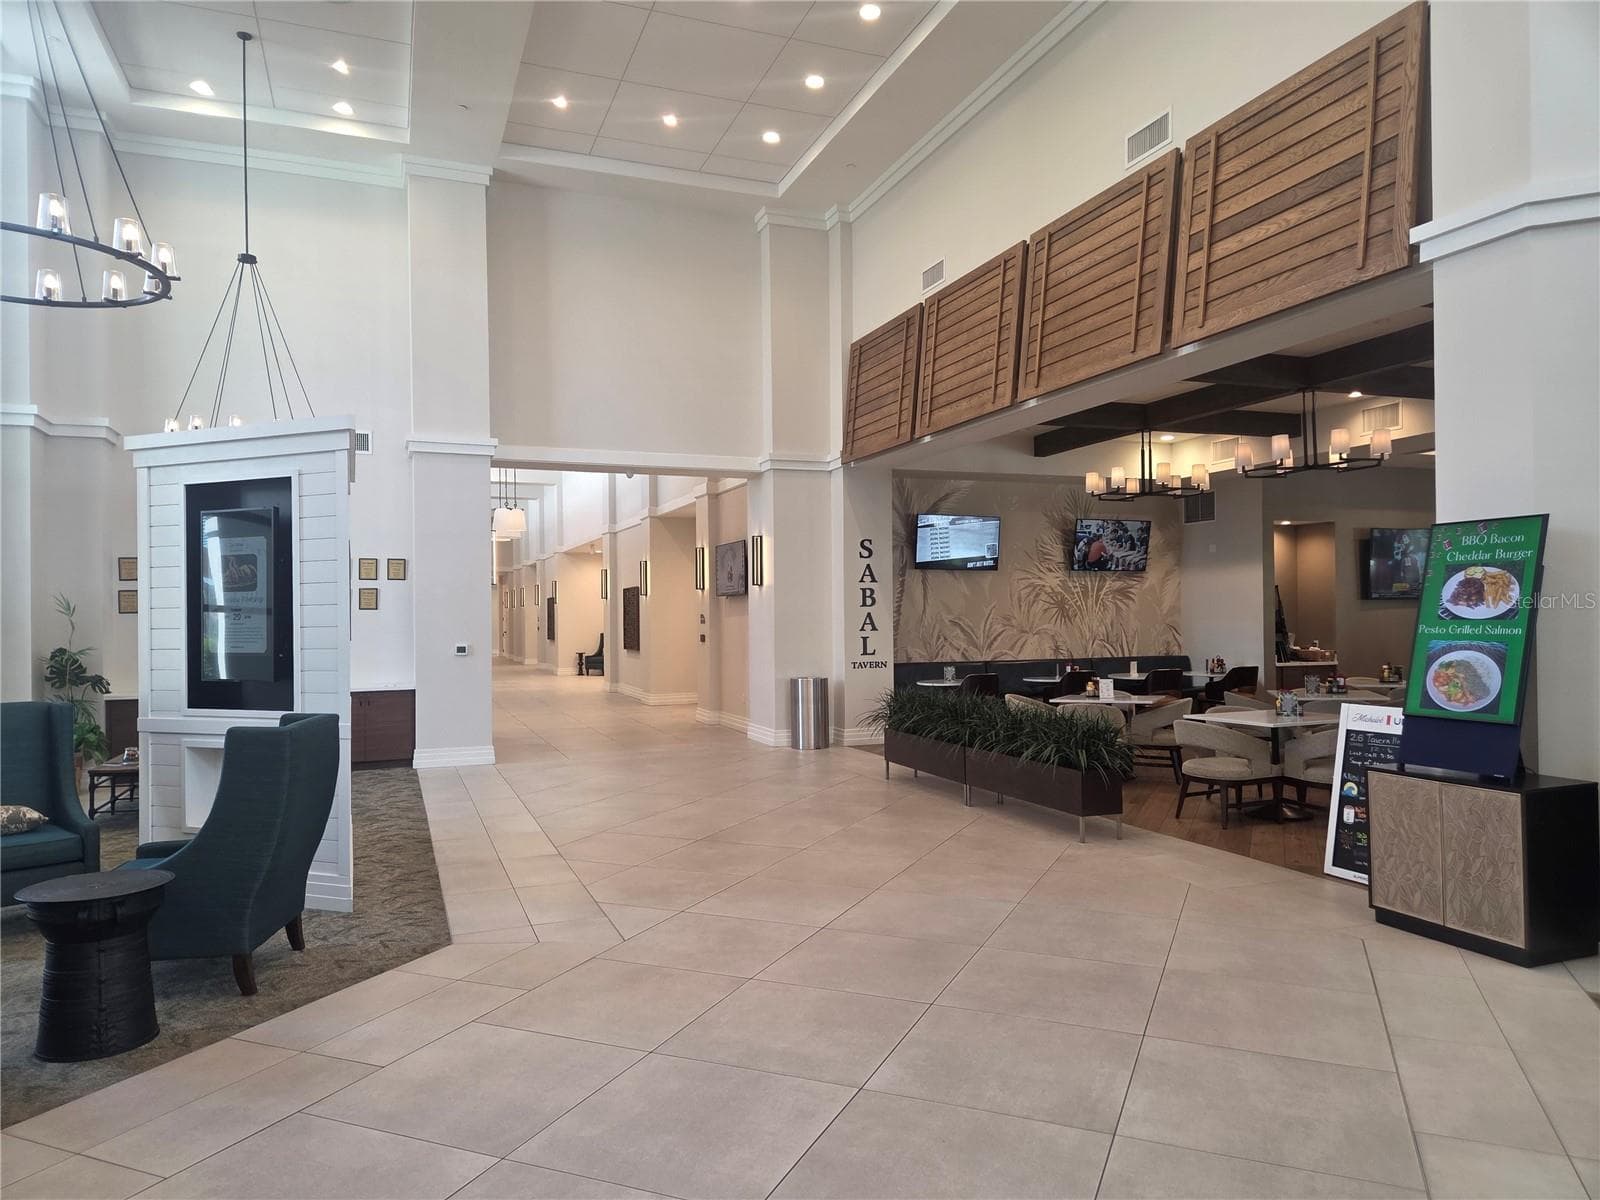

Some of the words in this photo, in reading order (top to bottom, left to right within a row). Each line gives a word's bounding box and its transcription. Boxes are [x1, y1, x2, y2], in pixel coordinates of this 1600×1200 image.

[1461, 534, 1487, 547] BBQ
[1490, 533, 1525, 544] Bacon
[1446, 551, 1491, 562] Cheddar
[1495, 549, 1534, 561] Burger
[859, 539, 878, 656] SABAL
[1418, 624, 1446, 634] Pesto
[1450, 624, 1482, 635] Grilled
[1485, 625, 1522, 635] Salmon
[851, 661, 888, 669] TAVERN
